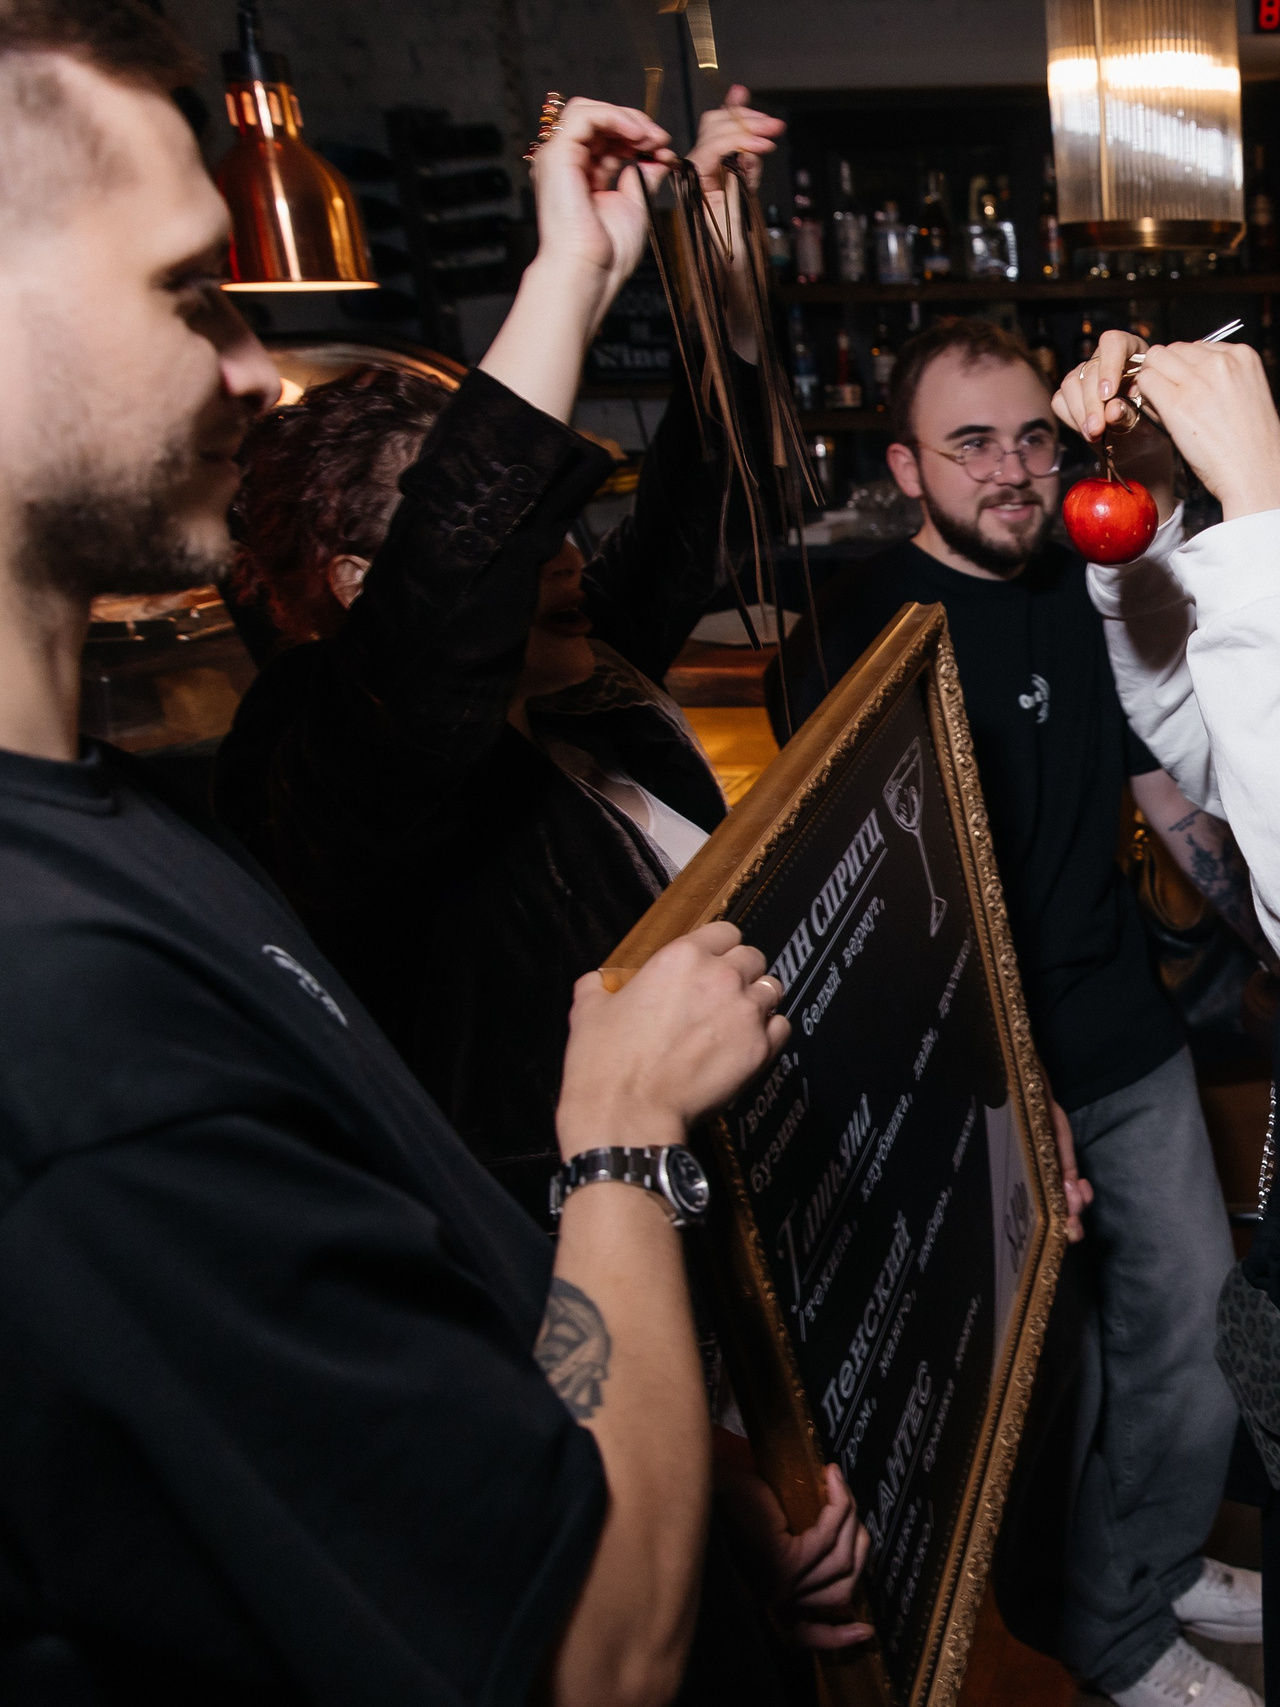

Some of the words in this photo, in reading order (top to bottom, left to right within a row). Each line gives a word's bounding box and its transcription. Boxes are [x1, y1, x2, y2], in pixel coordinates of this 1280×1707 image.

[810, 807, 887, 938] СПРИТЦ
[801, 961, 843, 1037] белый
[775, 1091, 873, 1316] Татьяна
[820, 1210, 912, 1439] Ленский
[864, 1359, 933, 1570] ДАНТЕС
